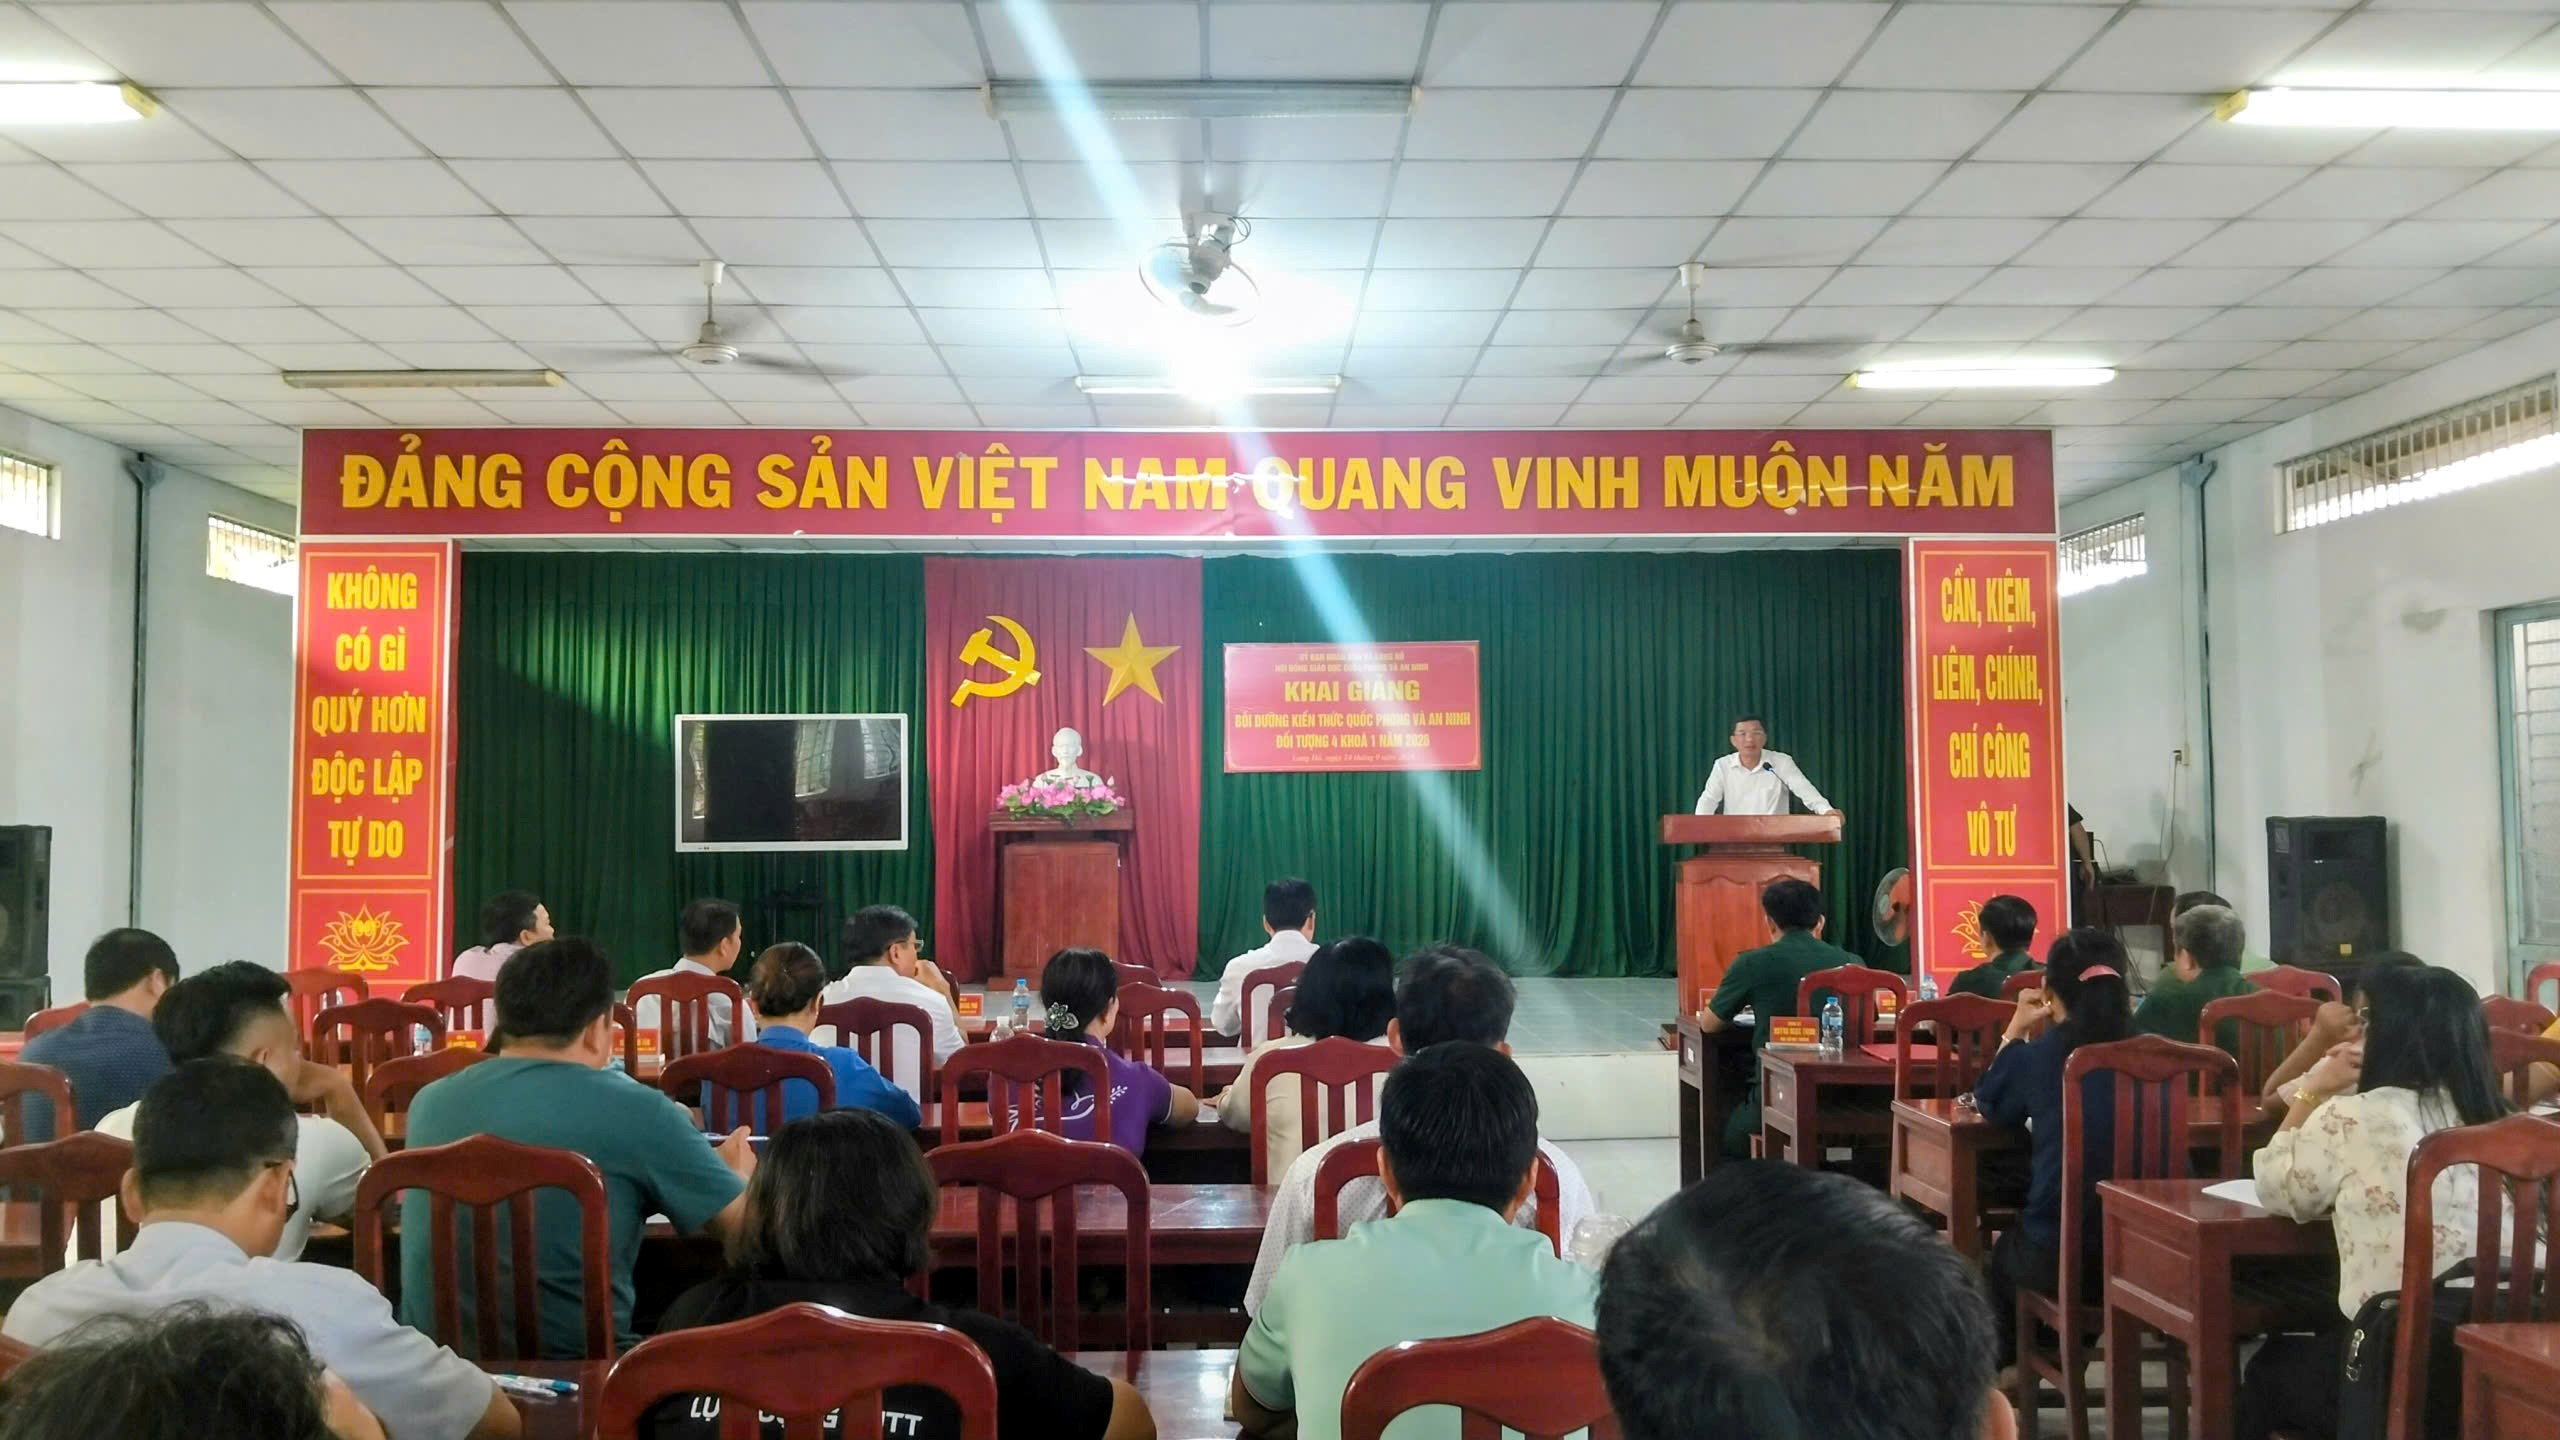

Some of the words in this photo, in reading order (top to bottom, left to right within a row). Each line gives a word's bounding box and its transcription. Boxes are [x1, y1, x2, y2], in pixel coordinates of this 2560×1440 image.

[340, 433, 522, 508] ĐẢNG
[546, 439, 730, 522] CỘNG
[756, 436, 888, 509] SẢN
[914, 442, 1058, 523] VIỆT
[1085, 455, 1230, 510] NAM
[1252, 455, 1468, 517] QUANG
[1493, 455, 1638, 510] VINH
[1664, 440, 1847, 509] MUÔN
[1869, 442, 2015, 508] NĂM
[327, 565, 417, 609] KHÔNG
[1941, 563, 1982, 628] CẦN,
[1986, 568, 2036, 632] KIỆM,
[335, 626, 371, 671] CÓ
[379, 626, 406, 671] GÌ
[1284, 681, 1340, 702] KHAI
[1347, 674, 1420, 702] GIẢNG
[1933, 645, 1980, 706] LIÊM,
[1985, 646, 2043, 706] CHÍNH,
[312, 688, 363, 737] QUÝ
[371, 691, 426, 733] HƠN
[1235, 710, 1252, 728] BỒI
[1254, 711, 1289, 728] DƯỠNG
[1291, 710, 1316, 728] KIẾN
[1318, 710, 1344, 727] THỨC
[1346, 708, 1373, 728] QUỐC
[1412, 709, 1426, 726] VÀ
[1428, 712, 1442, 726] AN
[1445, 712, 1471, 726] NINH
[1276, 729, 1293, 748] ĐỐI
[1296, 733, 1329, 751] TƯỢNG
[1331, 735, 1338, 748] 4
[1371, 735, 1376, 748] 1
[1379, 731, 1403, 748] NĂM
[1949, 723, 1979, 778] CHÍ
[1983, 723, 2031, 778] CÔNG
[311, 751, 365, 803] ĐỘC
[373, 751, 423, 803] LẬP
[328, 816, 363, 866] TỰ
[367, 821, 404, 858] DO
[1967, 801, 1990, 857] VÔ
[1994, 804, 2017, 857] TƯ
